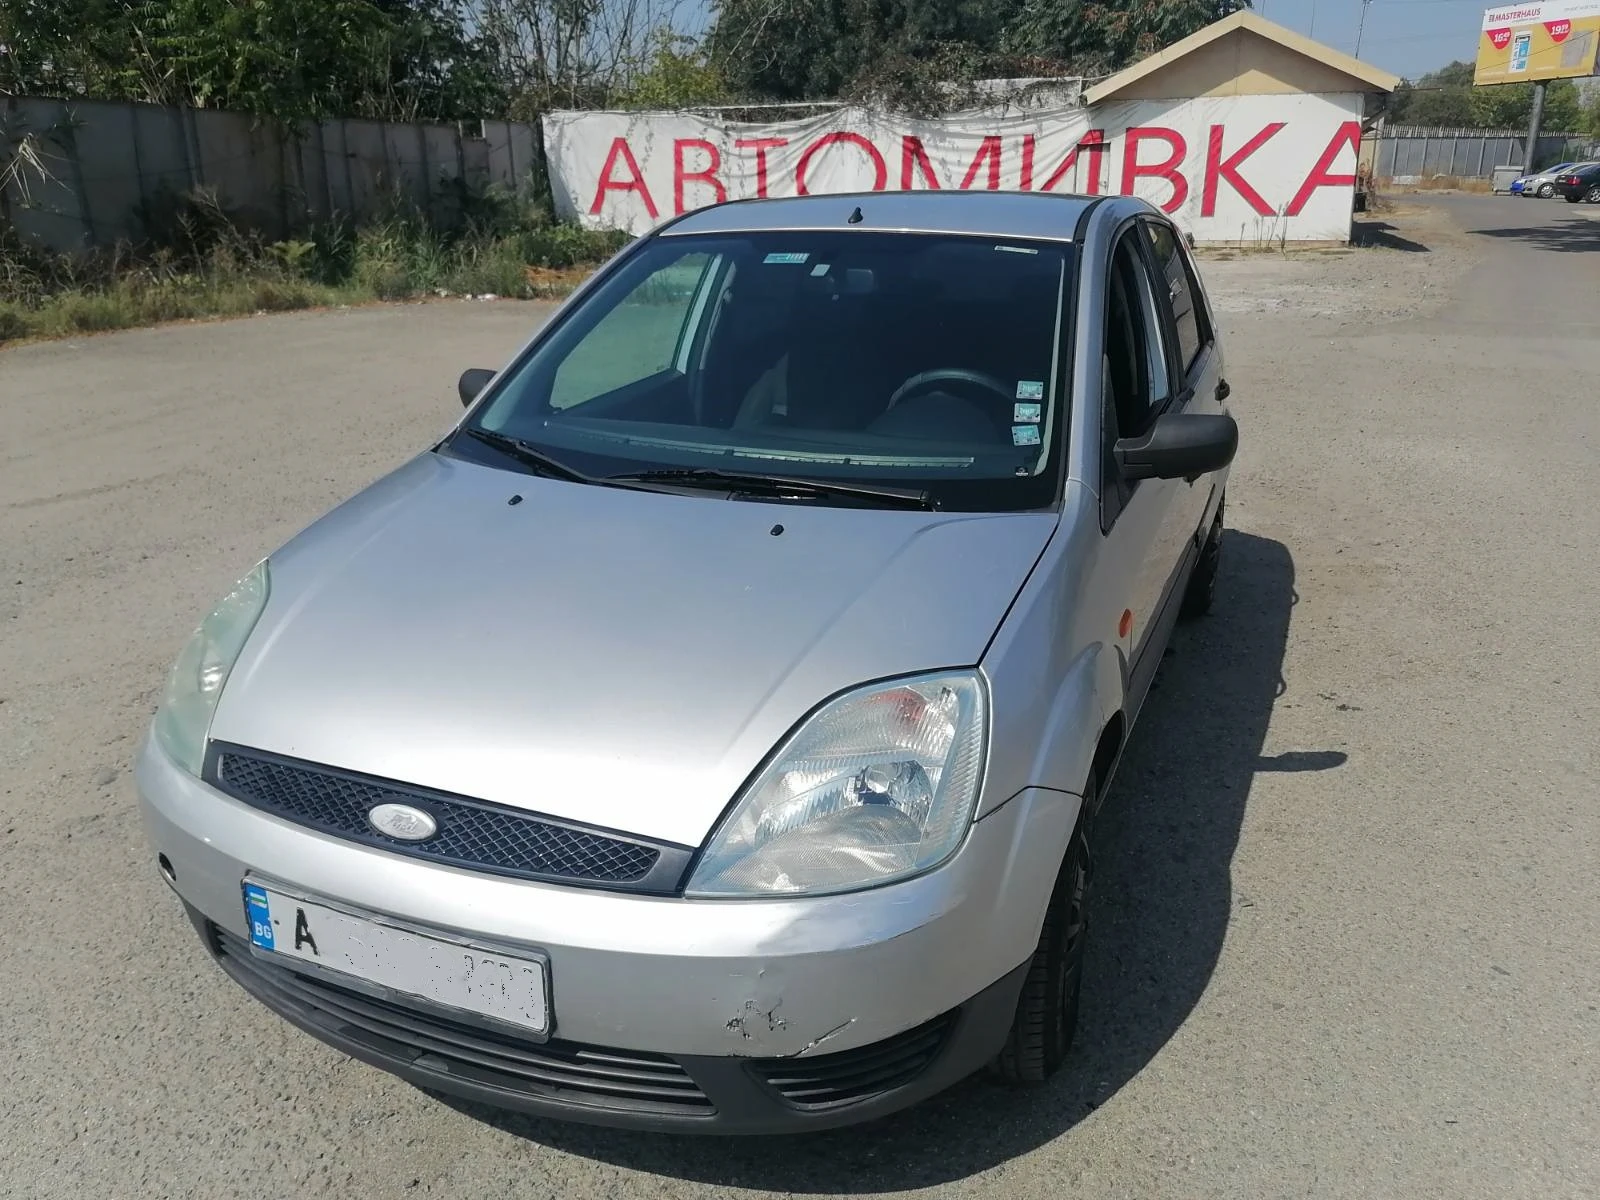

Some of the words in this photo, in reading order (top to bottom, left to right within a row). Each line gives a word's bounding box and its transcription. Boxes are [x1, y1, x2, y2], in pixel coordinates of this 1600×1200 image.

[1494, 8, 1541, 21] MASTERHAUS
[589, 121, 1361, 218] АВТОМИВКА
[254, 920, 273, 939] BG
